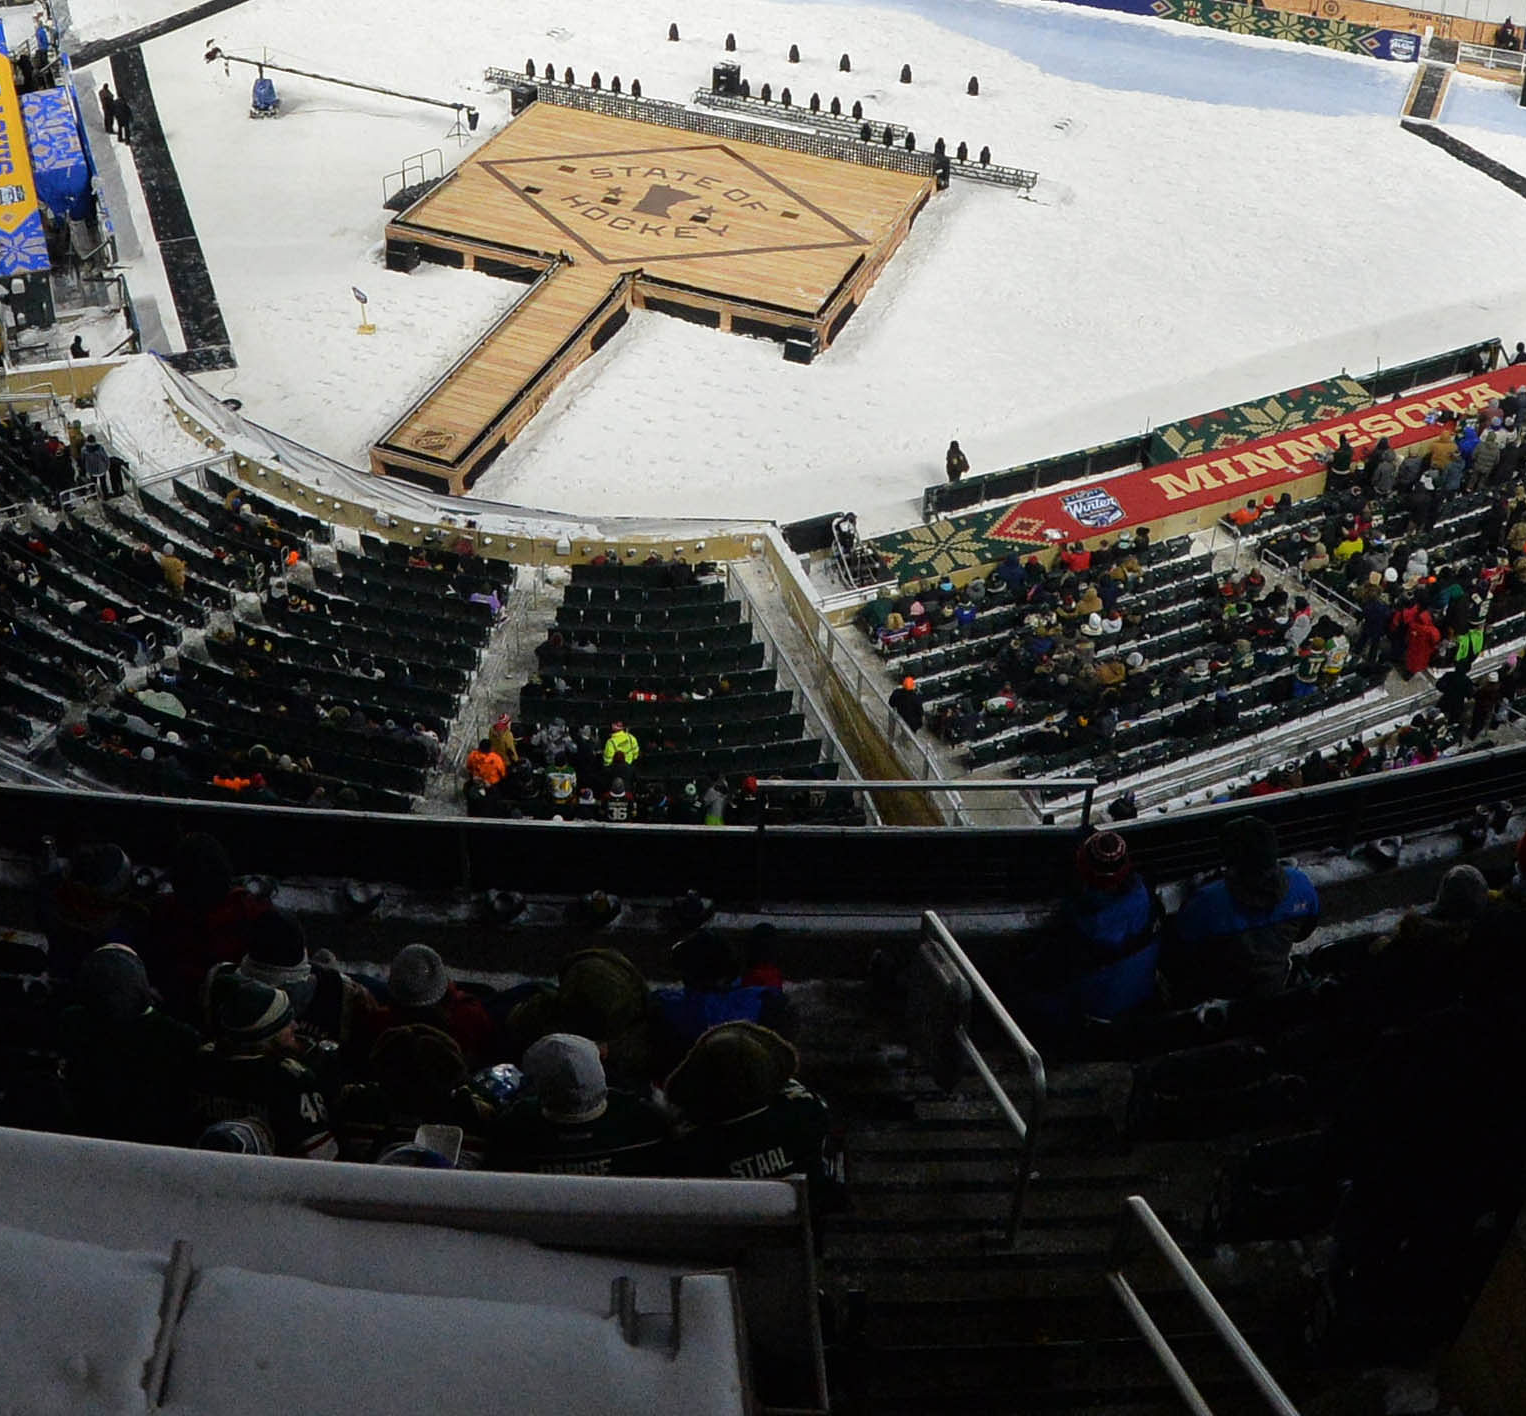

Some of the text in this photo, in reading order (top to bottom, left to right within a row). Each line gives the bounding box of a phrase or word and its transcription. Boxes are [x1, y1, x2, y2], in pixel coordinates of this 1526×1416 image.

[590, 166, 769, 212] STATE OF
[560, 193, 730, 239] HOCKEY
[1150, 383, 1508, 501] MINNESOTA
[1066, 496, 1117, 516] Winter
[729, 1145, 794, 1180] STAAL
